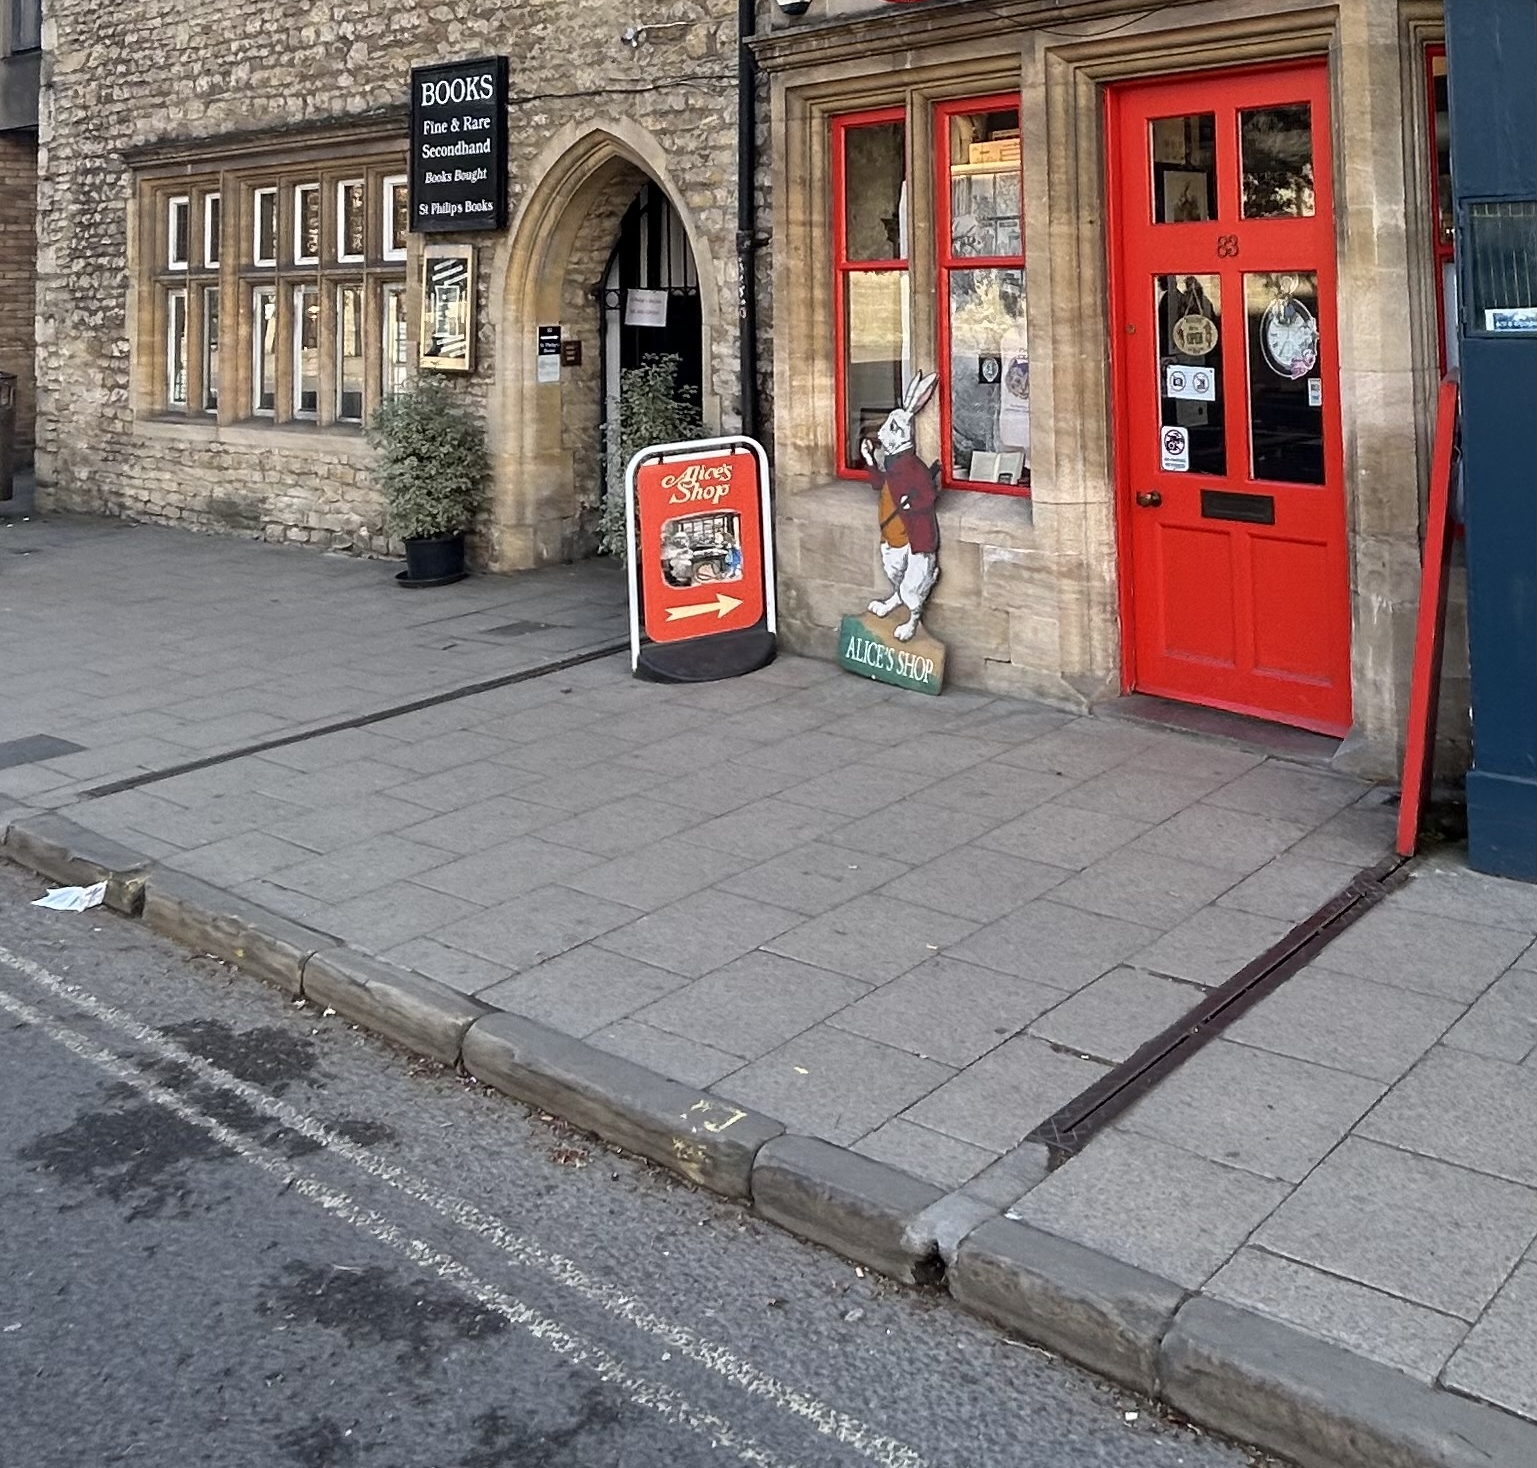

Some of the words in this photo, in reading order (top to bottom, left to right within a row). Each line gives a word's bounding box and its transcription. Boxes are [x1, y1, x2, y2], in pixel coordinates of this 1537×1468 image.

[421, 74, 493, 107] BOOKS
[423, 120, 449, 135] Fine
[450, 117, 460, 132] &
[463, 116, 491, 131] Rare
[421, 137, 491, 159] Secondhand
[425, 170, 452, 184] Books
[454, 167, 488, 184] Bought
[418, 203, 429, 216] St
[464, 198, 494, 213] Books
[1217, 234, 1239, 259] 83
[661, 463, 733, 489] Alice's
[668, 479, 730, 505] Shop
[845, 635, 895, 672] ALICE'S
[896, 650, 934, 684] SHOP
